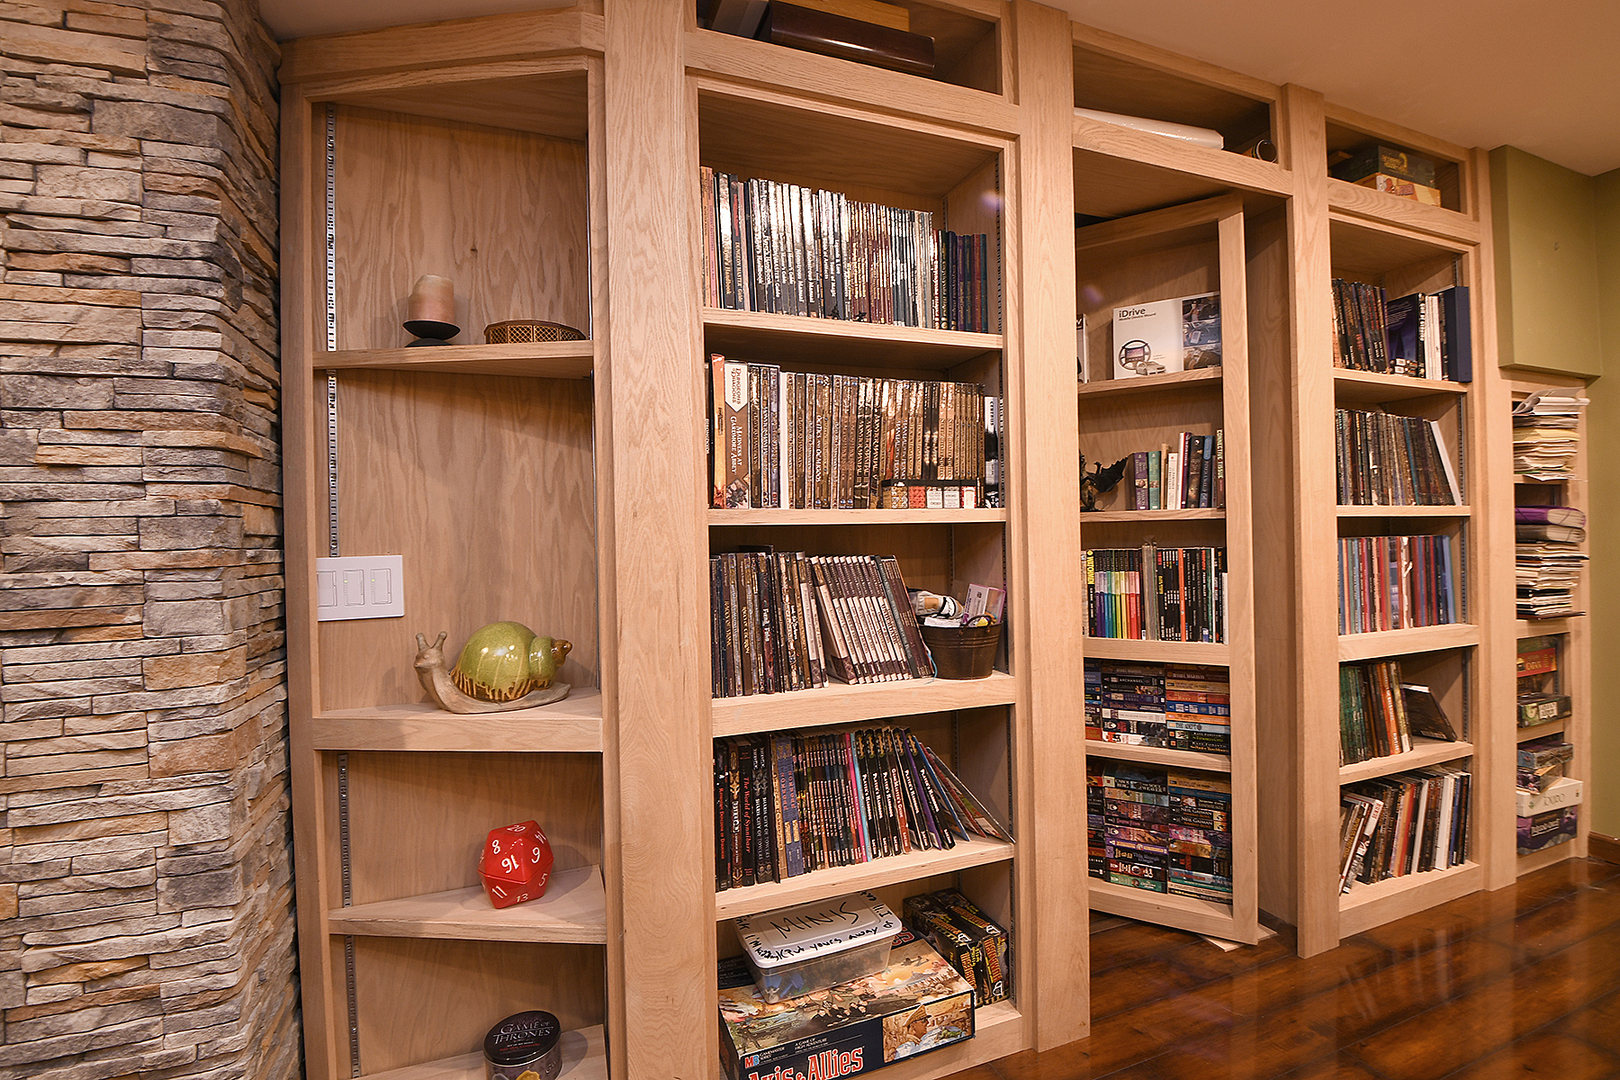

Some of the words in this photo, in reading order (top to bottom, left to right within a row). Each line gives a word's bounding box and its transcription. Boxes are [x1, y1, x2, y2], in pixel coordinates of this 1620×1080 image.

[734, 242, 742, 266] DUNGEON
[806, 250, 814, 280] Monstrous
[724, 266, 732, 294] Handbook
[756, 254, 764, 284] Handbook
[764, 256, 772, 284] Handbook
[736, 288, 744, 302] Guide
[808, 282, 816, 302] Manual
[1118, 308, 1146, 318] iDrive
[730, 371, 738, 404] DRAGONS
[730, 416, 738, 451] GARDMORE
[736, 426, 744, 456] MADNESS
[900, 419, 908, 446] MANUAL
[730, 452, 738, 473] ABBEY
[736, 456, 744, 466] AT
[1086, 556, 1096, 584] WATCHMEN
[762, 608, 770, 626] Fiend
[872, 772, 880, 794] PLAYER'S
[882, 772, 890, 794] PLAYER'S
[886, 794, 894, 818] HANDBOOK
[904, 770, 912, 792] PLAYER'S
[910, 792, 920, 814] HANDBOOK
[920, 768, 929, 790] PLAYER'S
[928, 790, 940, 812] HANDBOOK
[1192, 818, 1213, 826] GAIMAN
[492, 839, 501, 854] 8
[743, 818, 752, 852] Synnibarr
[492, 885, 508, 899] 11
[538, 873, 548, 887] 5
[517, 893, 529, 903] 13
[770, 901, 859, 939] MINIS
[810, 937, 842, 951] yours
[848, 927, 878, 940] away
[493, 1029, 550, 1045] THRONES
[500, 1021, 539, 1034] GAME
[745, 1055, 760, 1069] MB
[808, 1046, 864, 1080] Allies
